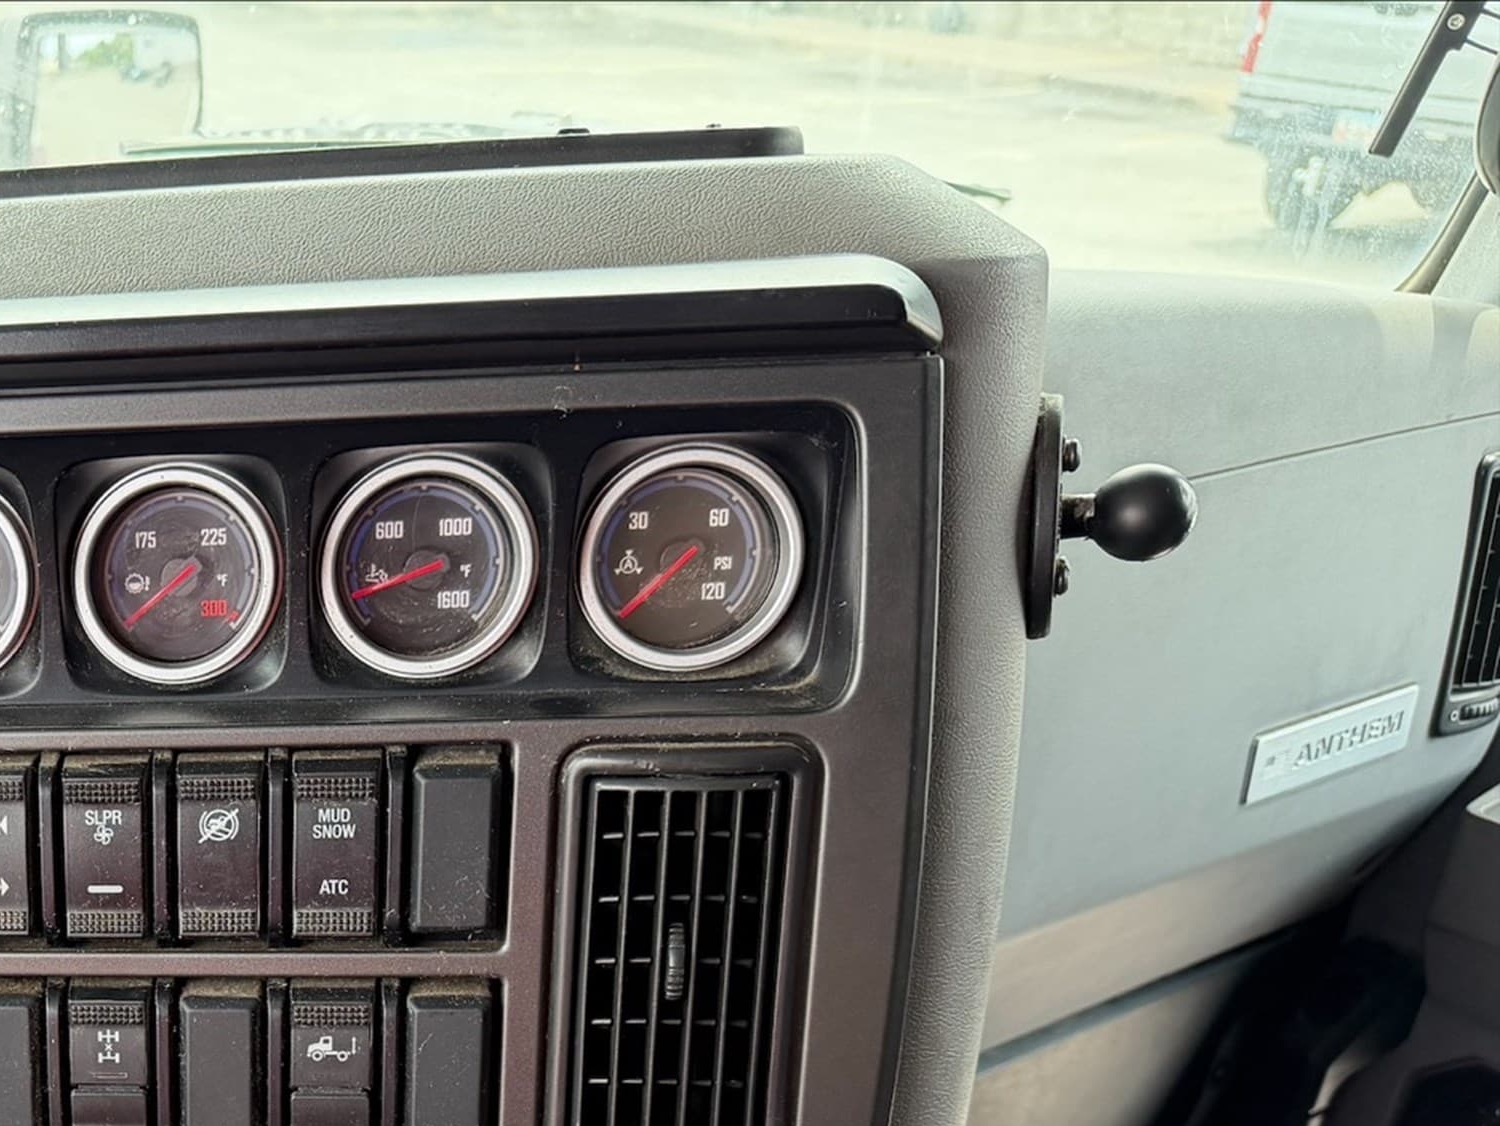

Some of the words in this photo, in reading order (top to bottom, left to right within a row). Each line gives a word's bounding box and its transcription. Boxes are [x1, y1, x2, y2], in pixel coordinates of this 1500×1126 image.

[628, 511, 649, 531] 30
[708, 508, 729, 527] 60
[375, 520, 404, 539] 600
[438, 518, 472, 537] 1000
[135, 530, 157, 549] 175
[200, 528, 227, 547] 225
[713, 556, 732, 571] PSI
[436, 590, 470, 609] 1600
[700, 582, 725, 601] 120
[200, 599, 228, 618] 300
[1293, 711, 1405, 767] ANTHEM
[85, 811, 122, 826] SLPR
[318, 808, 351, 824] MUD
[312, 823, 356, 839] SNOW
[319, 880, 349, 895] ATC
